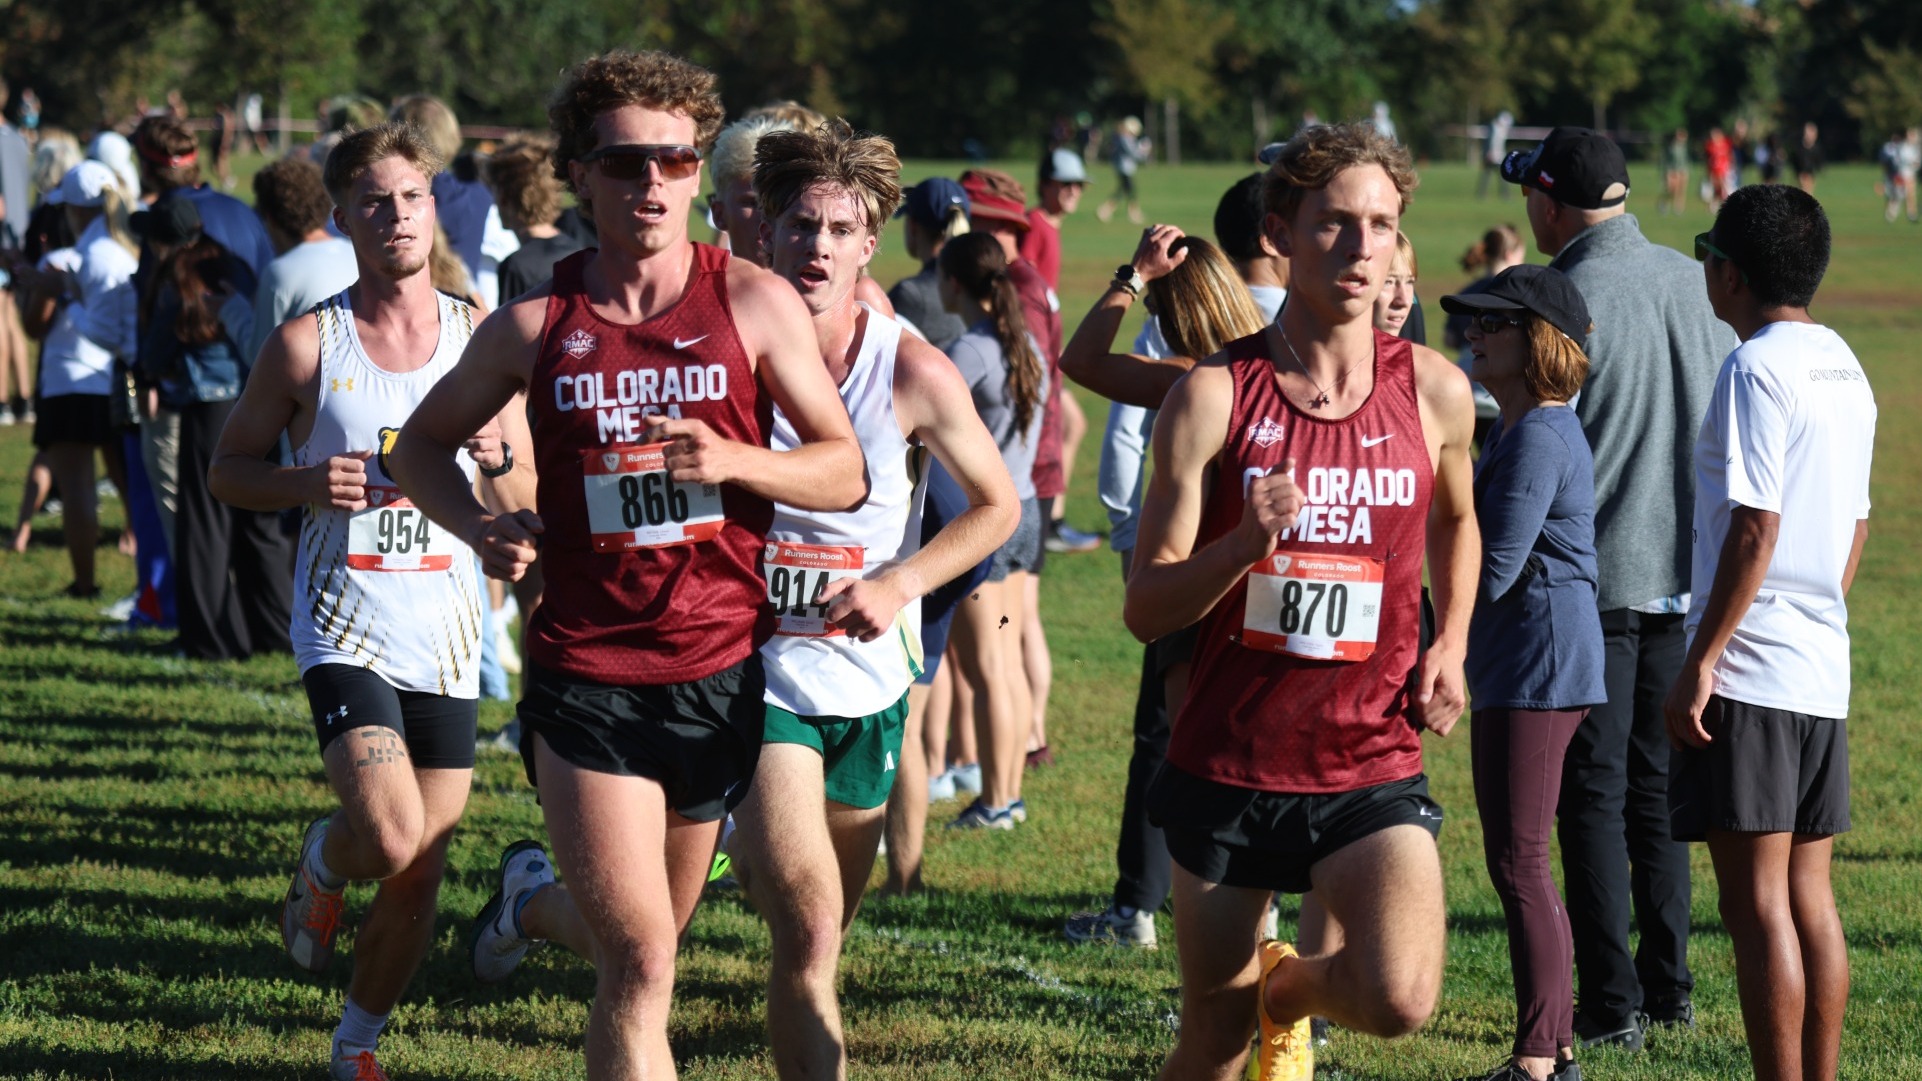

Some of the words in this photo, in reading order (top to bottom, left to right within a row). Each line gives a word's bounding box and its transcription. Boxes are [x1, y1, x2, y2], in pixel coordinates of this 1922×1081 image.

[564, 339, 594, 350] RMAC
[554, 364, 727, 412] COLORADO
[627, 453, 664, 462] Runners
[619, 473, 689, 529] 866
[1243, 467, 1416, 506] CORADO
[377, 509, 430, 554] 954
[1281, 505, 1373, 544] MESA
[784, 549, 818, 559] Runners
[820, 551, 843, 560] Roost
[1298, 560, 1335, 571] Runners
[1336, 562, 1361, 572] Roost
[771, 567, 829, 618] 914
[1279, 580, 1348, 638] 870
